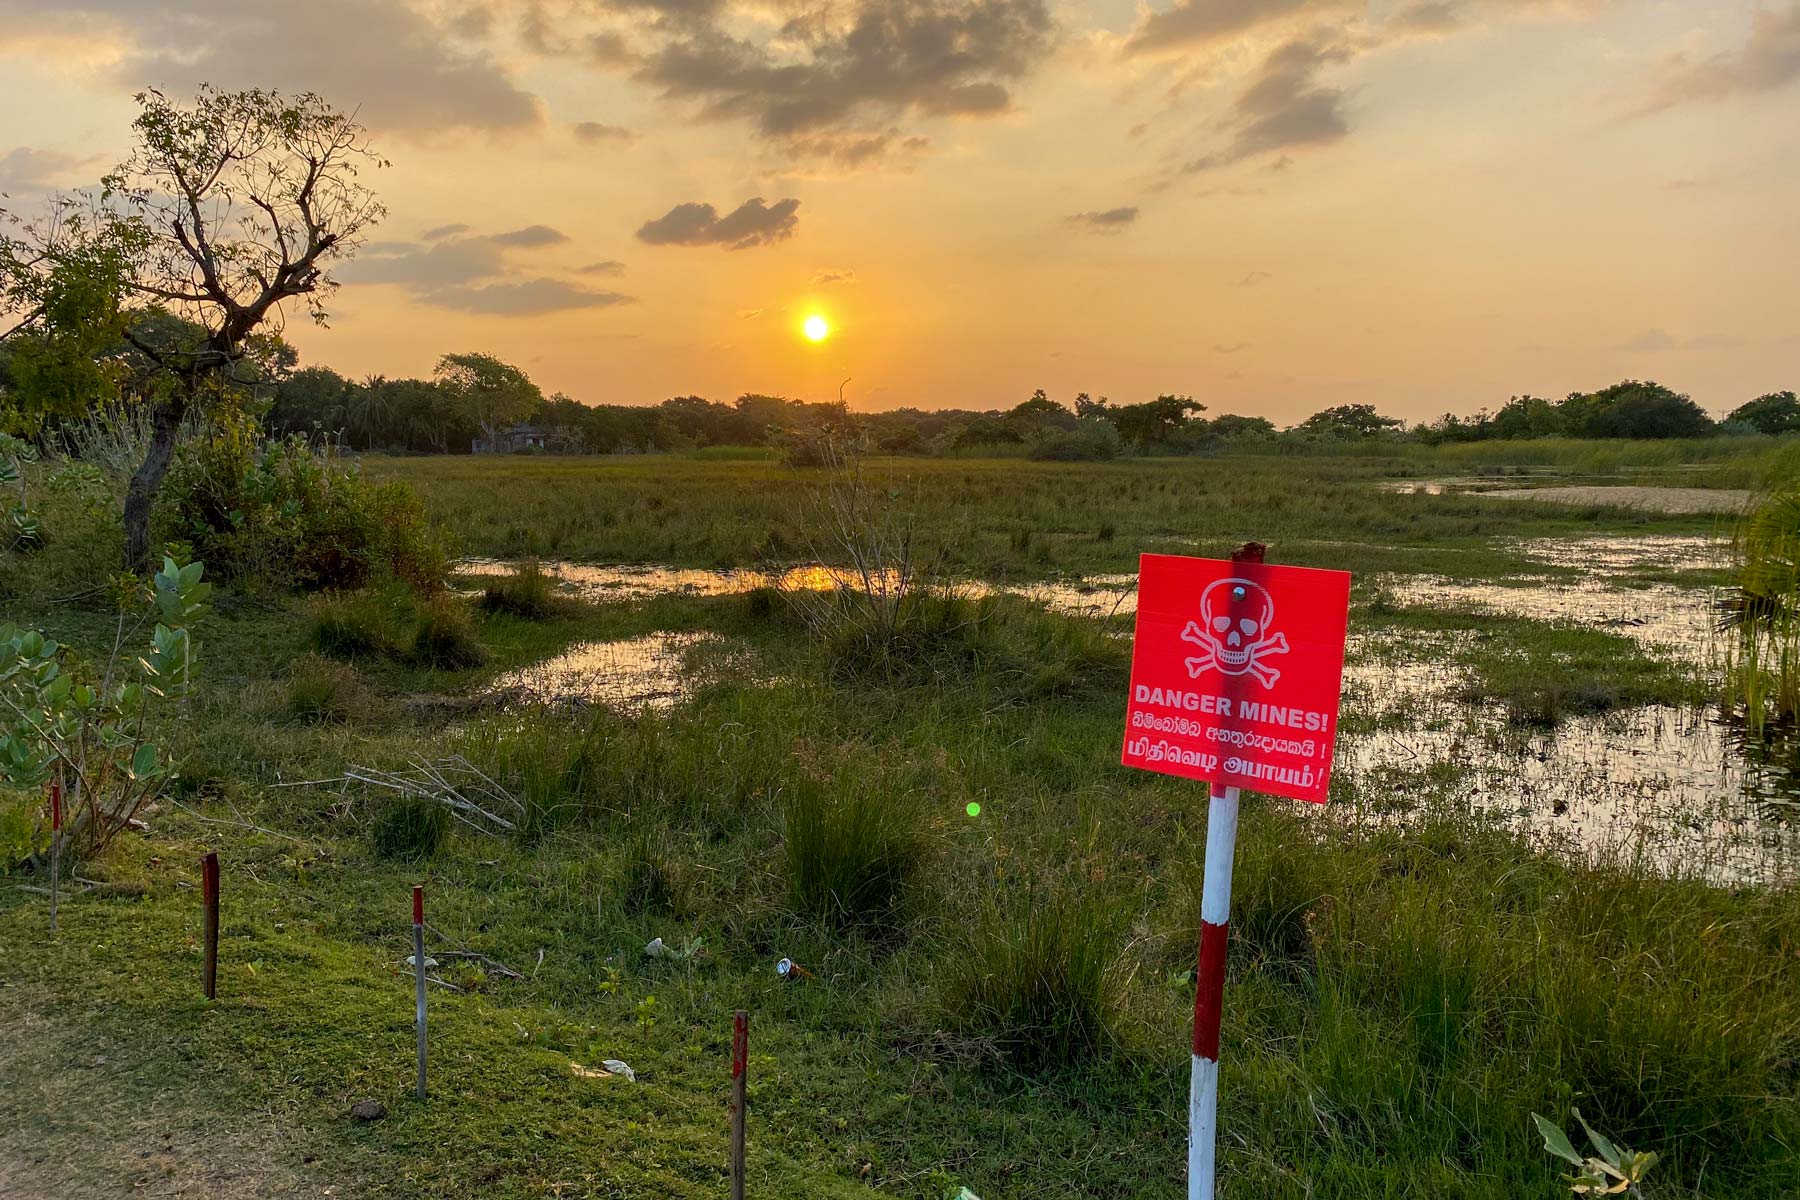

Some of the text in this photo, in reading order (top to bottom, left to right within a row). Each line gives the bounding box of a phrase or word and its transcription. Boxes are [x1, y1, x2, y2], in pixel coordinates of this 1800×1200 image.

[1135, 685, 1328, 732] DANGER MINES!
[1127, 736, 1218, 773] மிதிவெடி
